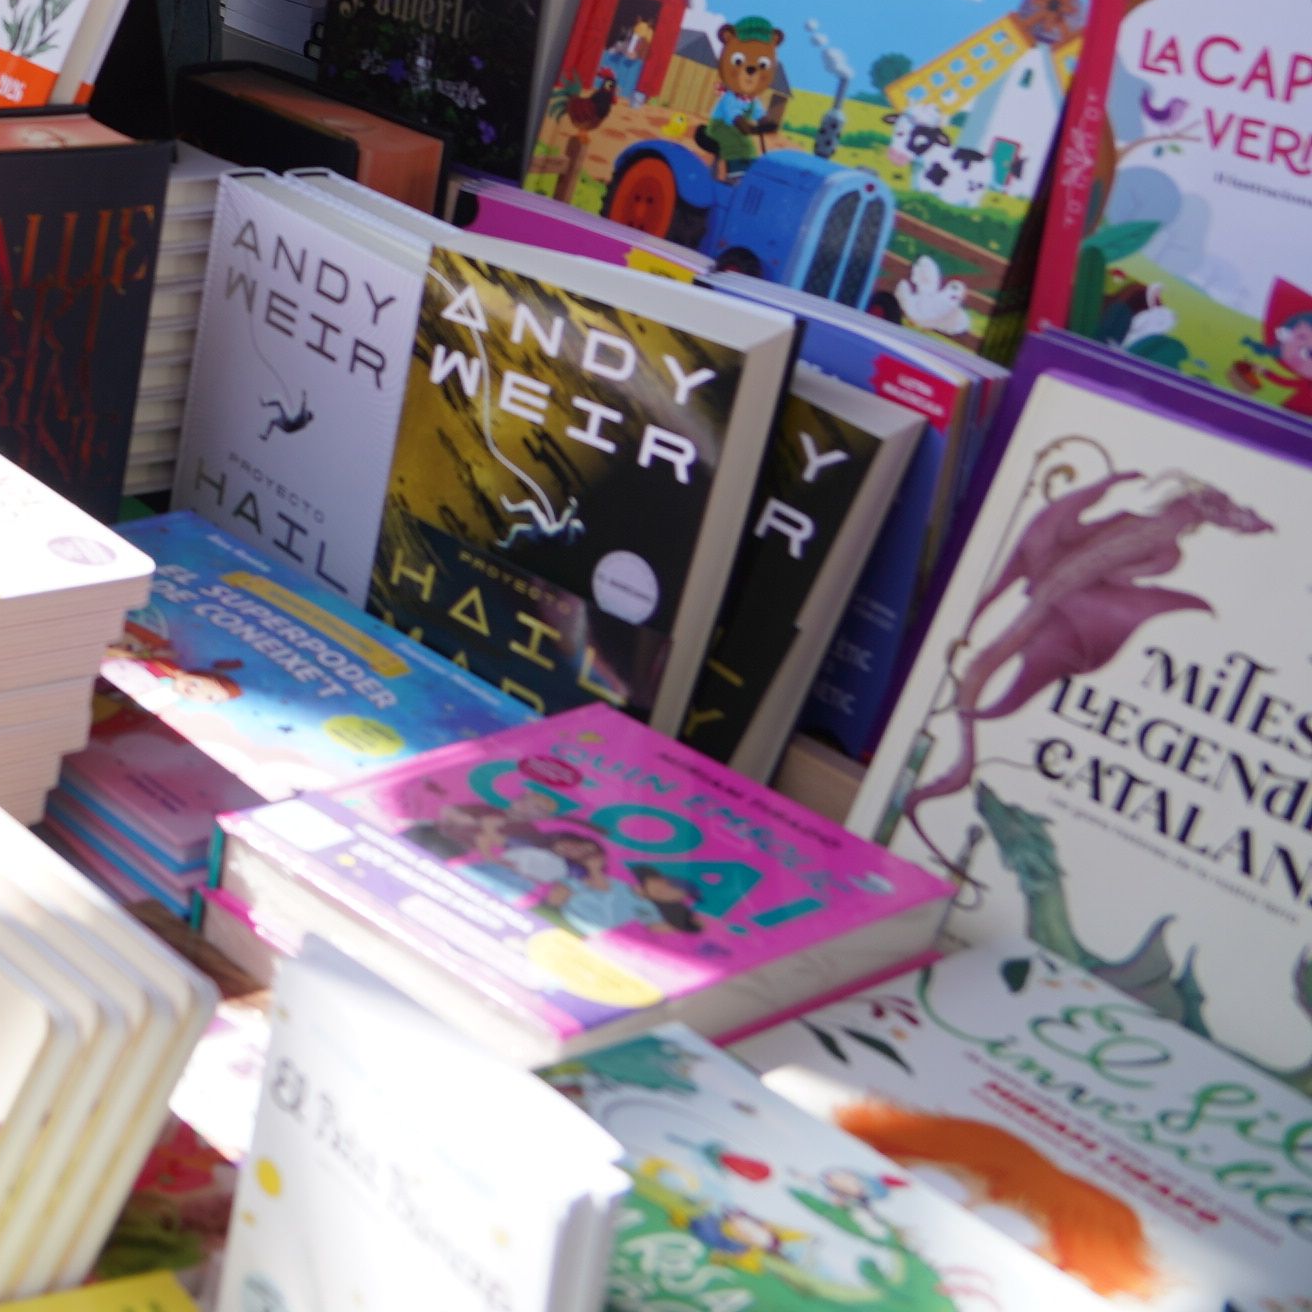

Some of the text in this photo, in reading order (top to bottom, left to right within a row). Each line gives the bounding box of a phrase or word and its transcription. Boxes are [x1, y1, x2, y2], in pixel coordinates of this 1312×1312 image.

[1139, 27, 1312, 104] LA CAP
[1203, 107, 1312, 180] VER
[225, 265, 387, 390] WEIR
[231, 218, 396, 327] ANDY
[441, 286, 717, 407] ANDY
[428, 344, 699, 485] WEIR
[192, 457, 349, 594] HAIL
[228, 451, 326, 525] PROYECTO
[390, 539, 626, 701] HAIL
[458, 549, 574, 613] PROYECTO
[199, 584, 398, 710] SUPERPODER
[550, 744, 675, 794] QUIN
